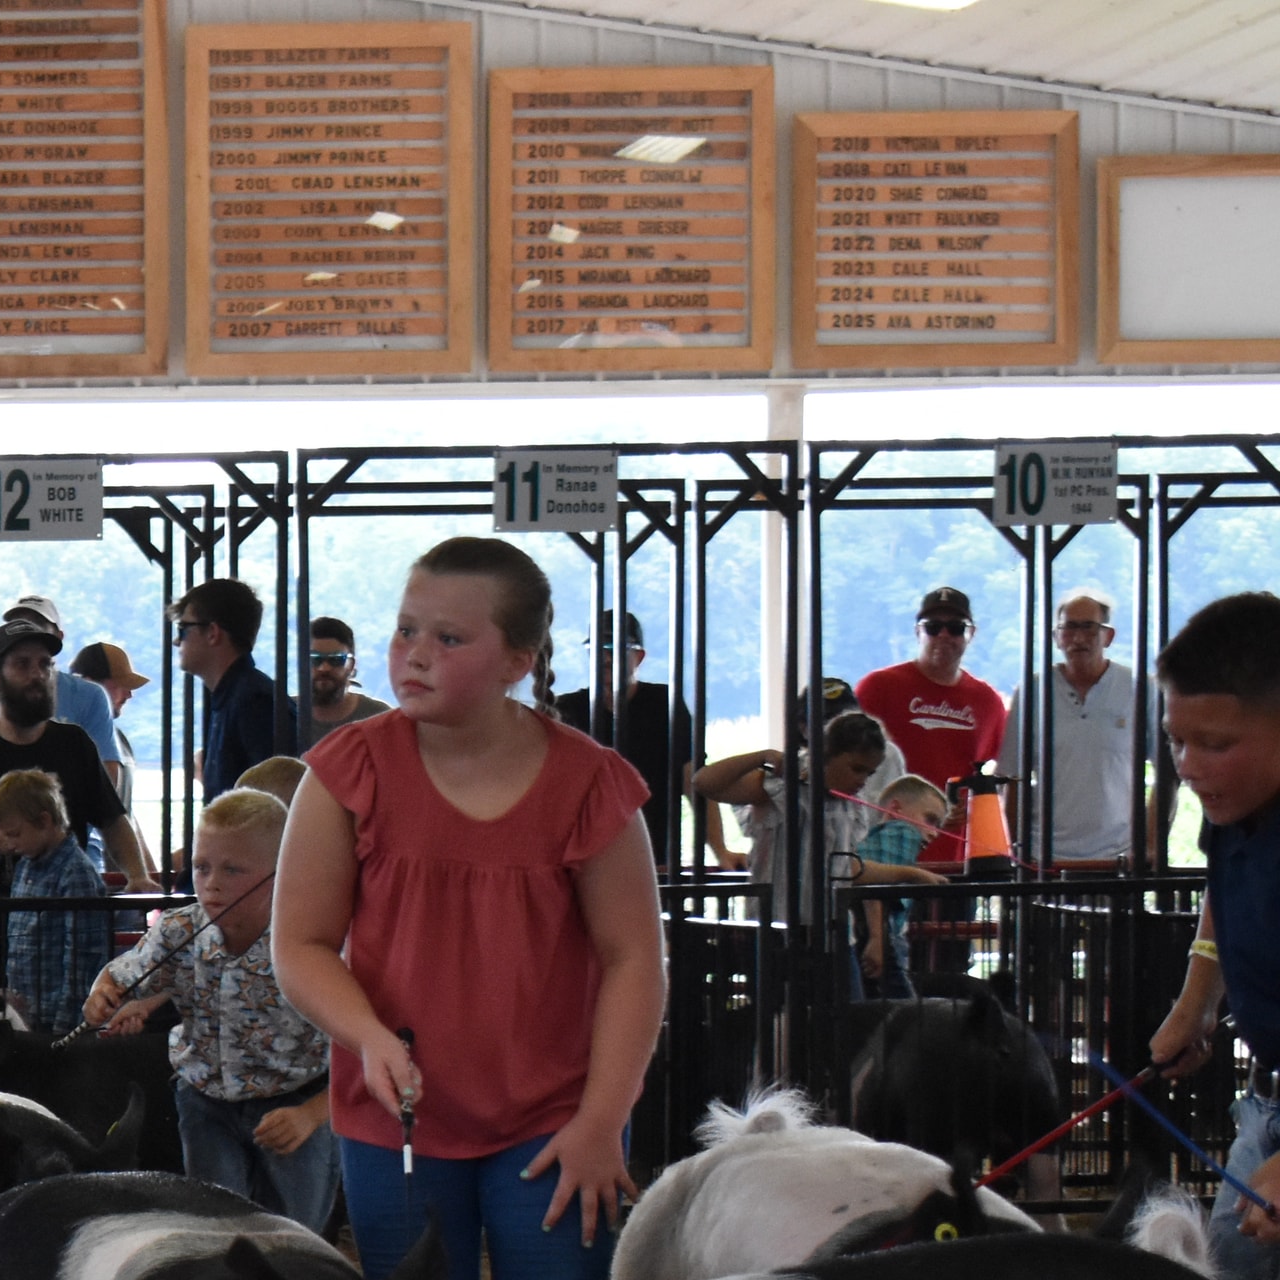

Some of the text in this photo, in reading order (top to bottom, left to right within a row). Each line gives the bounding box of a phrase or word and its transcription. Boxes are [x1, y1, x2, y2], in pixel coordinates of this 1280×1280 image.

[215, 74, 392, 88] 1997 BLAZER FARMS
[265, 101, 319, 113] BOGGS
[328, 100, 411, 112] BROTHERS
[266, 126, 314, 138] JIMMY
[325, 125, 383, 137] PRINCE
[216, 151, 386, 165] 2000 JIMMY PRINCE
[292, 177, 333, 189] CHAD
[344, 176, 420, 188] LENSMAN
[832, 188, 876, 201] 2020
[527, 196, 565, 209] 2012
[832, 213, 870, 226] 2021
[936, 212, 999, 226] FAULKNER
[9, 222, 84, 234] LENSMAN
[43, 246, 91, 258] LEWIS
[526, 246, 564, 259] 2014
[832, 262, 983, 276] 2023 CALE HALL
[30, 271, 80, 283] CLARK
[527, 295, 564, 308] 2016
[831, 288, 984, 302] 2024 CALE HALL
[24, 320, 70, 332] PRICE
[832, 315, 996, 329] 2025 AVA ASTORINO
[229, 321, 406, 337] 2007 GARRETT DALLAS
[543, 464, 613, 474] In Memory of
[46, 473, 85, 481] Memory
[87, 472, 98, 480] of
[556, 479, 597, 492] Ranae
[1000, 452, 1046, 516] 10
[47, 487, 76, 501] BOB
[499, 461, 539, 522] 11
[547, 500, 606, 513] Donohoe
[40, 508, 83, 522] WHITE
